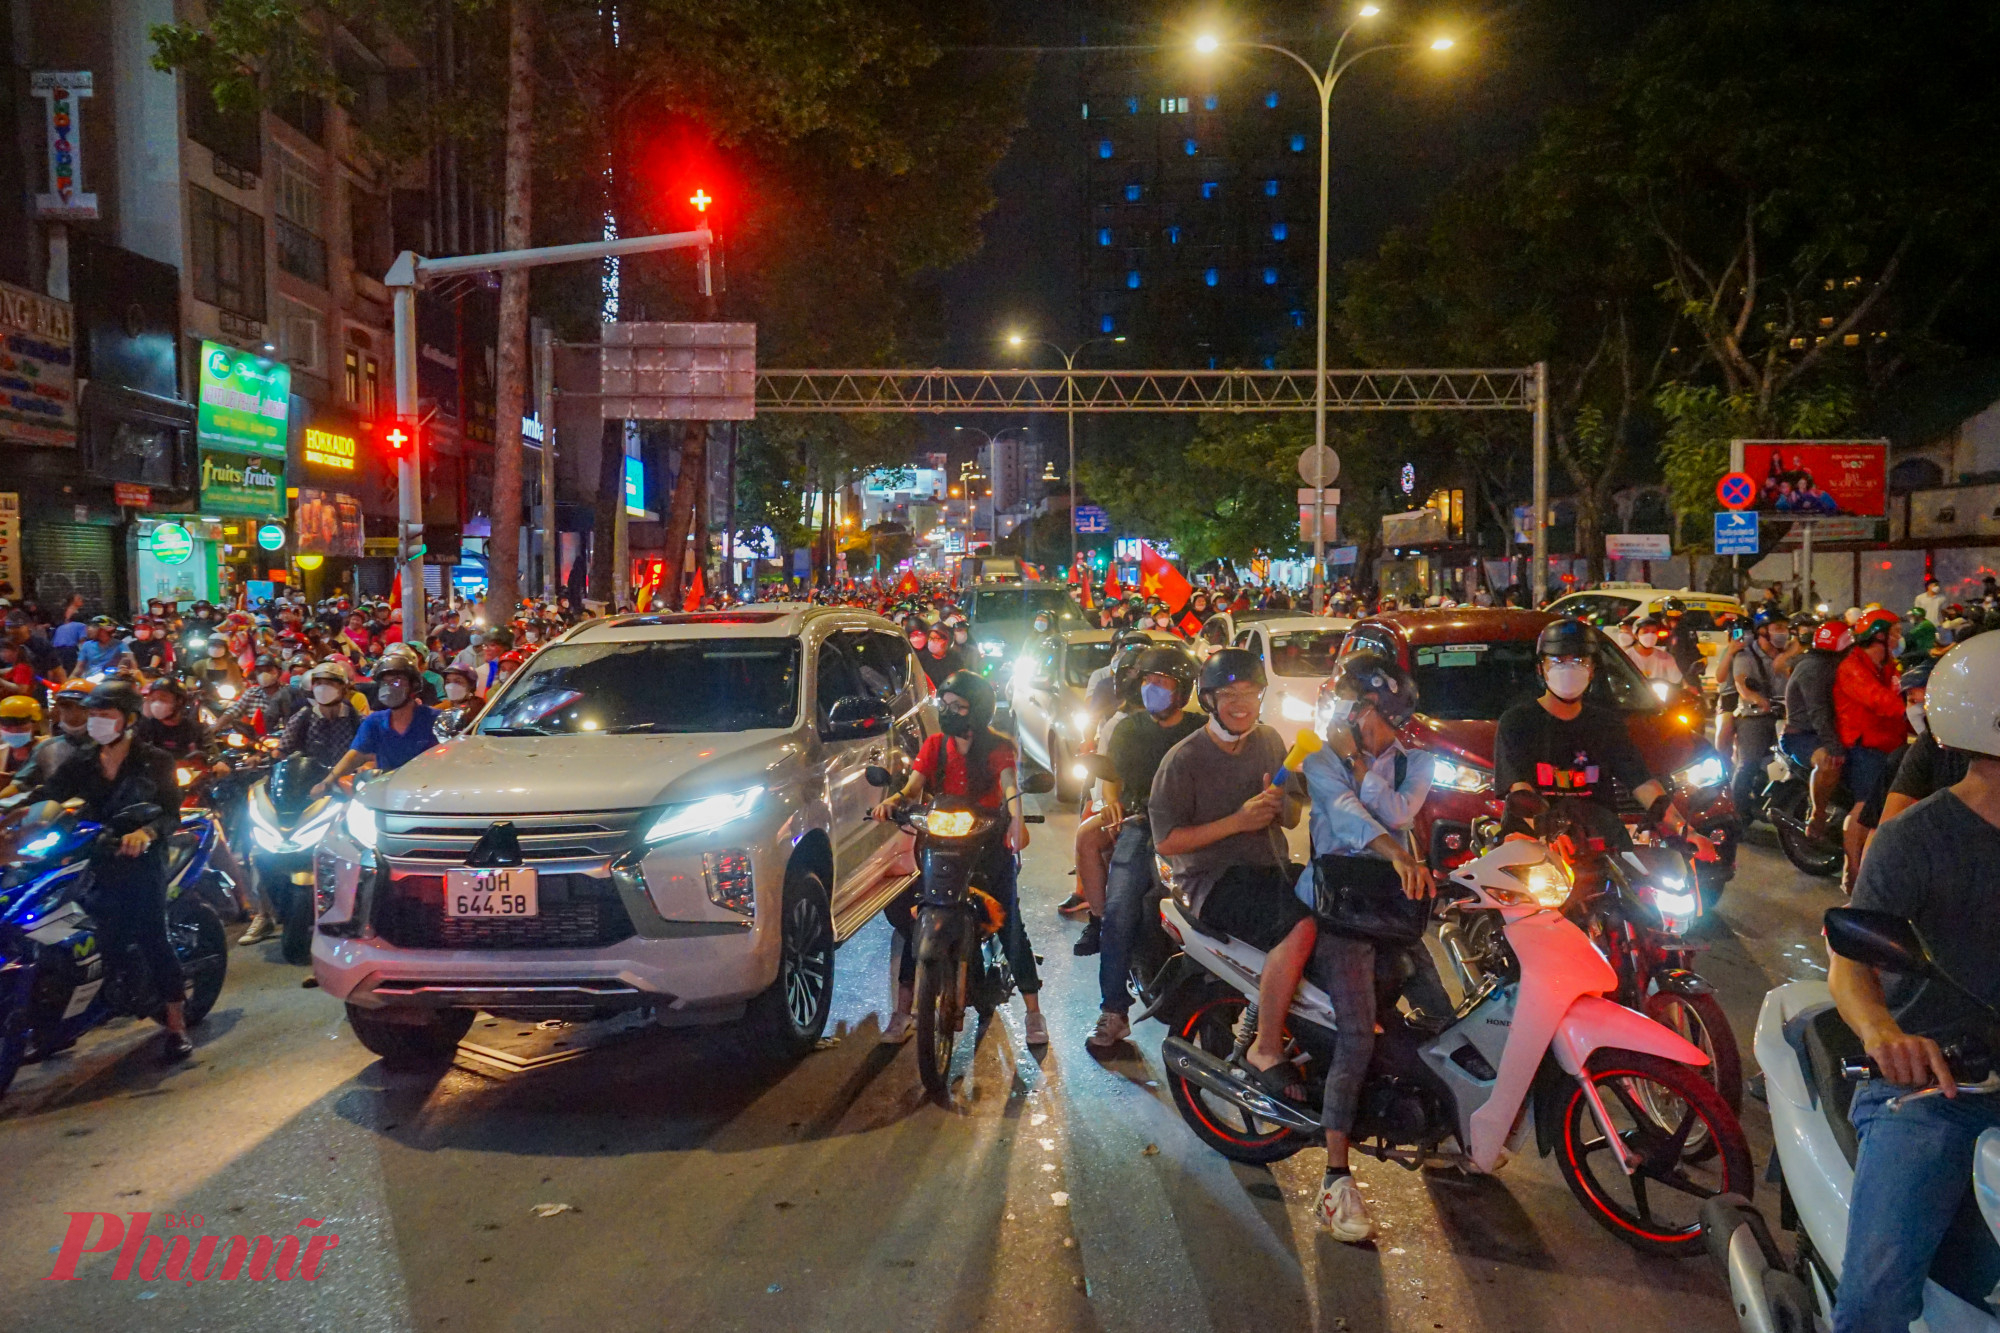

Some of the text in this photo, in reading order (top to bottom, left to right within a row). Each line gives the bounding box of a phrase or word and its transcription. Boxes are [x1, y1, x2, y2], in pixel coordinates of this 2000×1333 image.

[306, 429, 354, 457] HOKKAIDO
[201, 458, 277, 491] fruits fruits
[457, 894, 526, 915] 644.58
